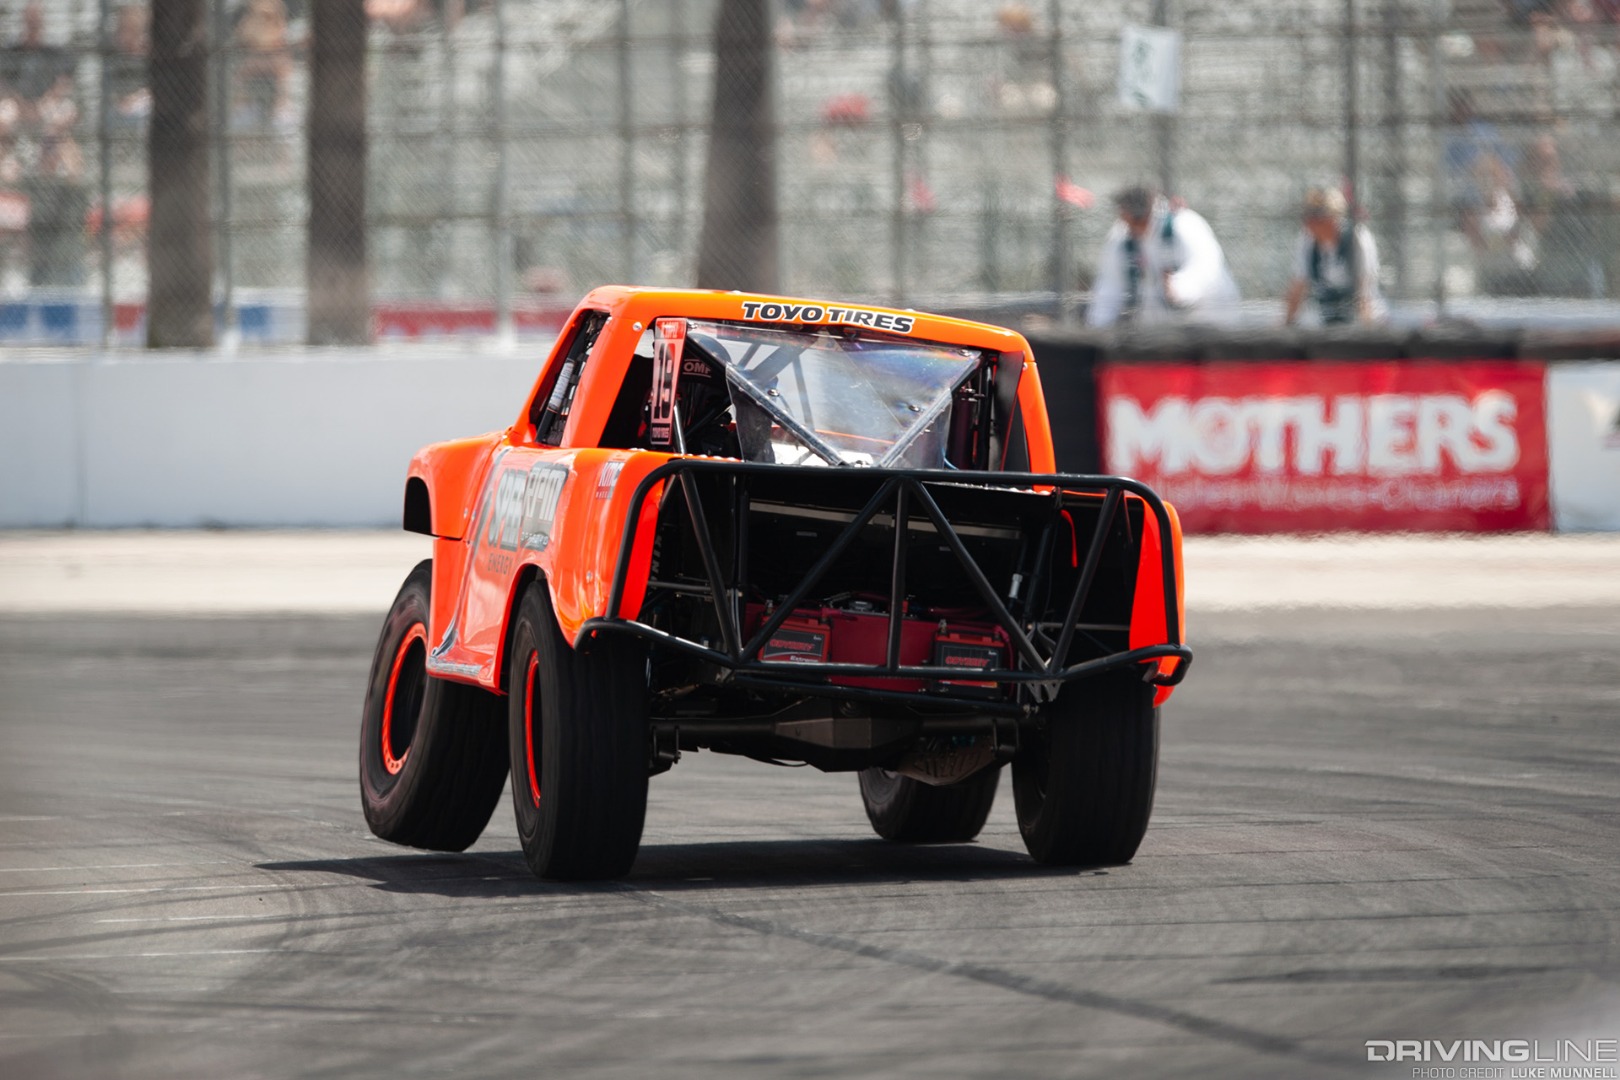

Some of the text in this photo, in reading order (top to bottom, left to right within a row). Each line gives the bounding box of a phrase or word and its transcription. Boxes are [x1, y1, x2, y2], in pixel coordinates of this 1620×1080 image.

[742, 301, 915, 333] TOYO TIRES
[1108, 389, 1520, 475] MOTHERS
[487, 552, 511, 576] ENERGY
